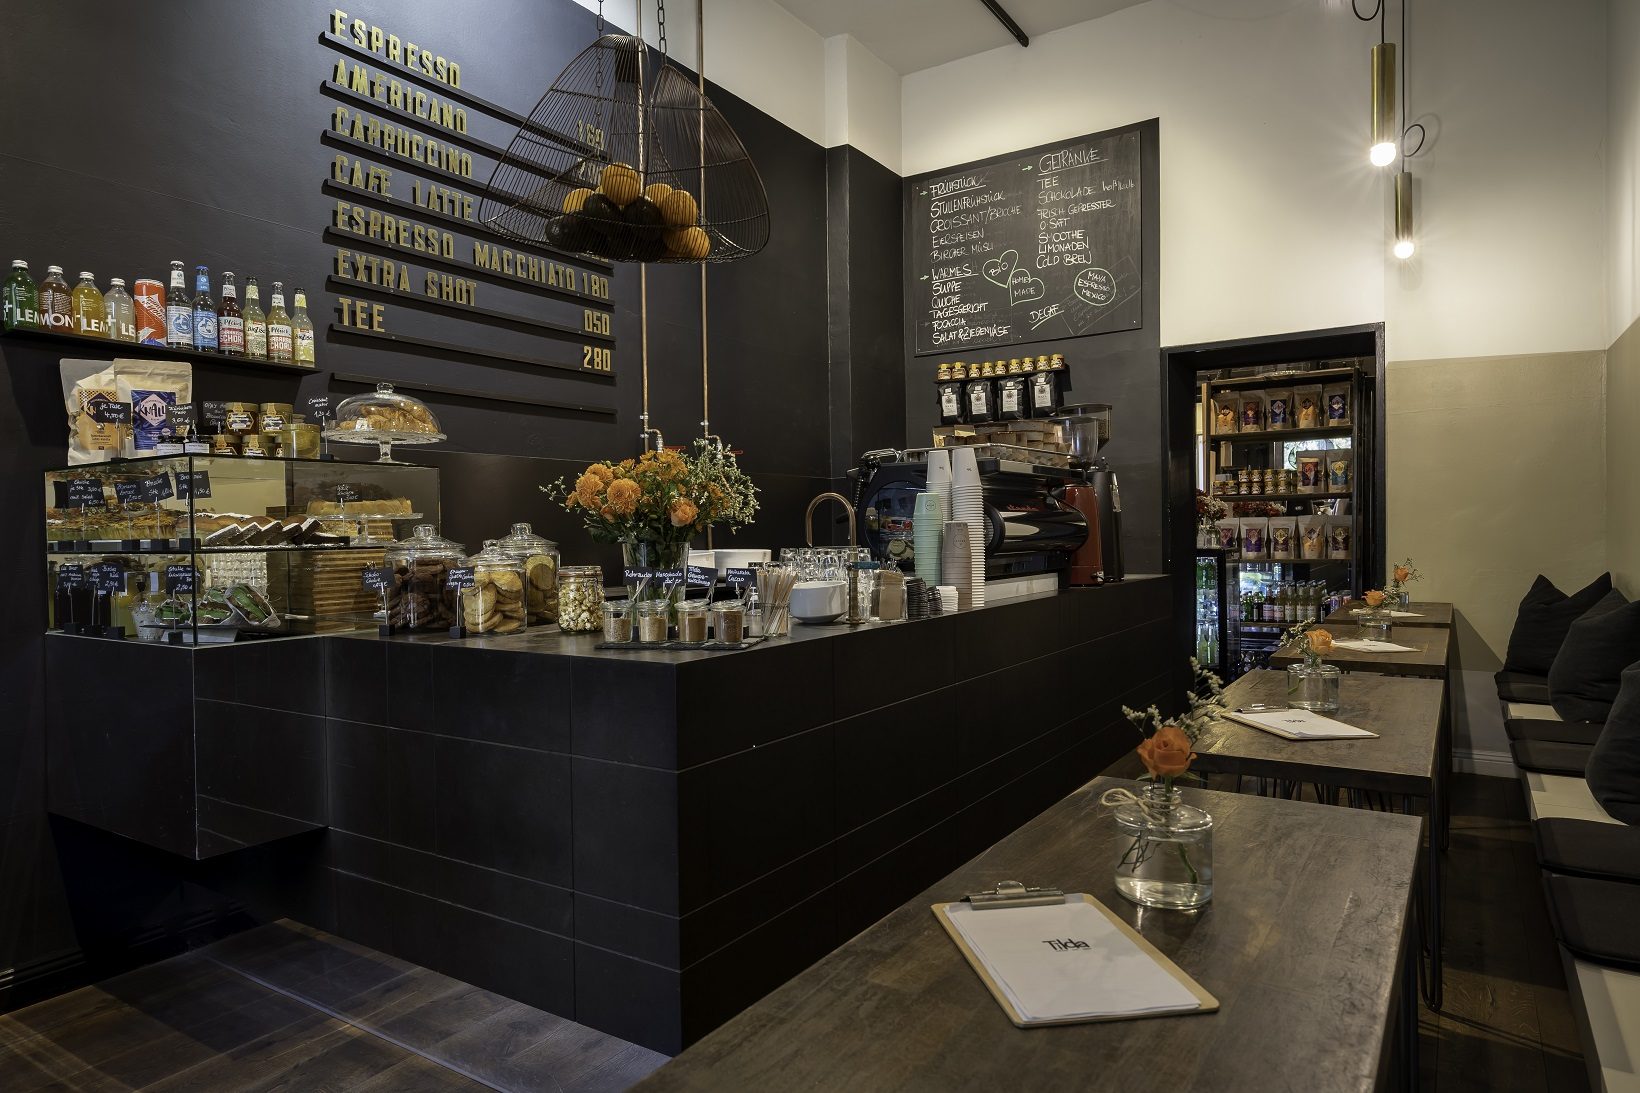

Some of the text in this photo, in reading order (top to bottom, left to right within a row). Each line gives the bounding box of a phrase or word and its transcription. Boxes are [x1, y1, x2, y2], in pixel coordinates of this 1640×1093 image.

[334, 9, 461, 89] ESPRESSO
[335, 59, 467, 135] AMERICANO
[335, 106, 472, 179] CAPPUCCINO
[335, 155, 474, 222] CAFE LATTE
[1037, 176, 1059, 189] TEE
[1038, 186, 1096, 205] SCHOKOLADE
[337, 201, 609, 300] ESPRESSO MACCHIATO 180
[1039, 236, 1089, 254] LIMONADEN
[930, 247, 968, 263] BIRCHER
[1063, 251, 1091, 266] BREW
[932, 264, 972, 280] WARMES
[338, 249, 610, 336] EXTRA SHOT 050
[932, 281, 962, 295] SUPPE
[1014, 287, 1036, 297] MADE
[1081, 289, 1106, 300] MEXICO
[931, 294, 961, 308] QUICHE
[929, 302, 988, 319] TAGESGERICHT
[339, 297, 611, 372] TEE 280
[932, 331, 957, 344] SALAT
[1042, 939, 1090, 950] Tilda
